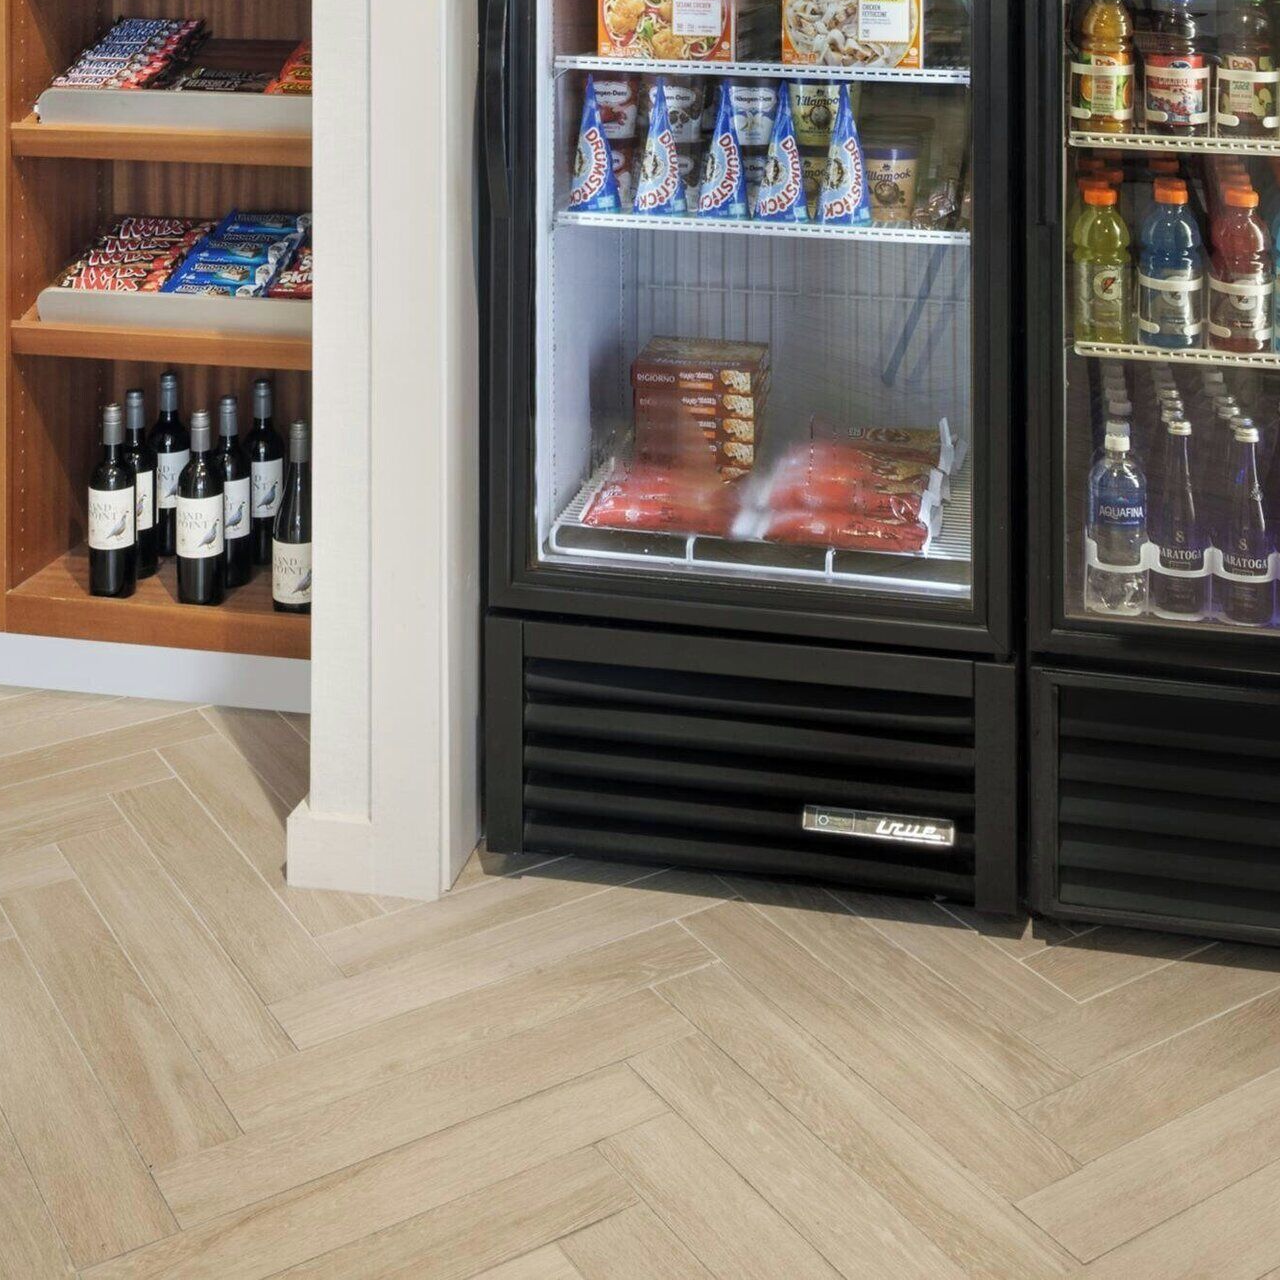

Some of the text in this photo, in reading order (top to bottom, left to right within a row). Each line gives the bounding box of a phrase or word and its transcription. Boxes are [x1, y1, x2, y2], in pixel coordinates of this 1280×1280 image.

[796, 94, 839, 107] Tillamoo
[639, 130, 679, 211] DRUMSTICK
[760, 135, 801, 216] DRUMSTICK
[824, 137, 863, 219] DRUMSTICK
[1099, 506, 1143, 519] AQUAFINA
